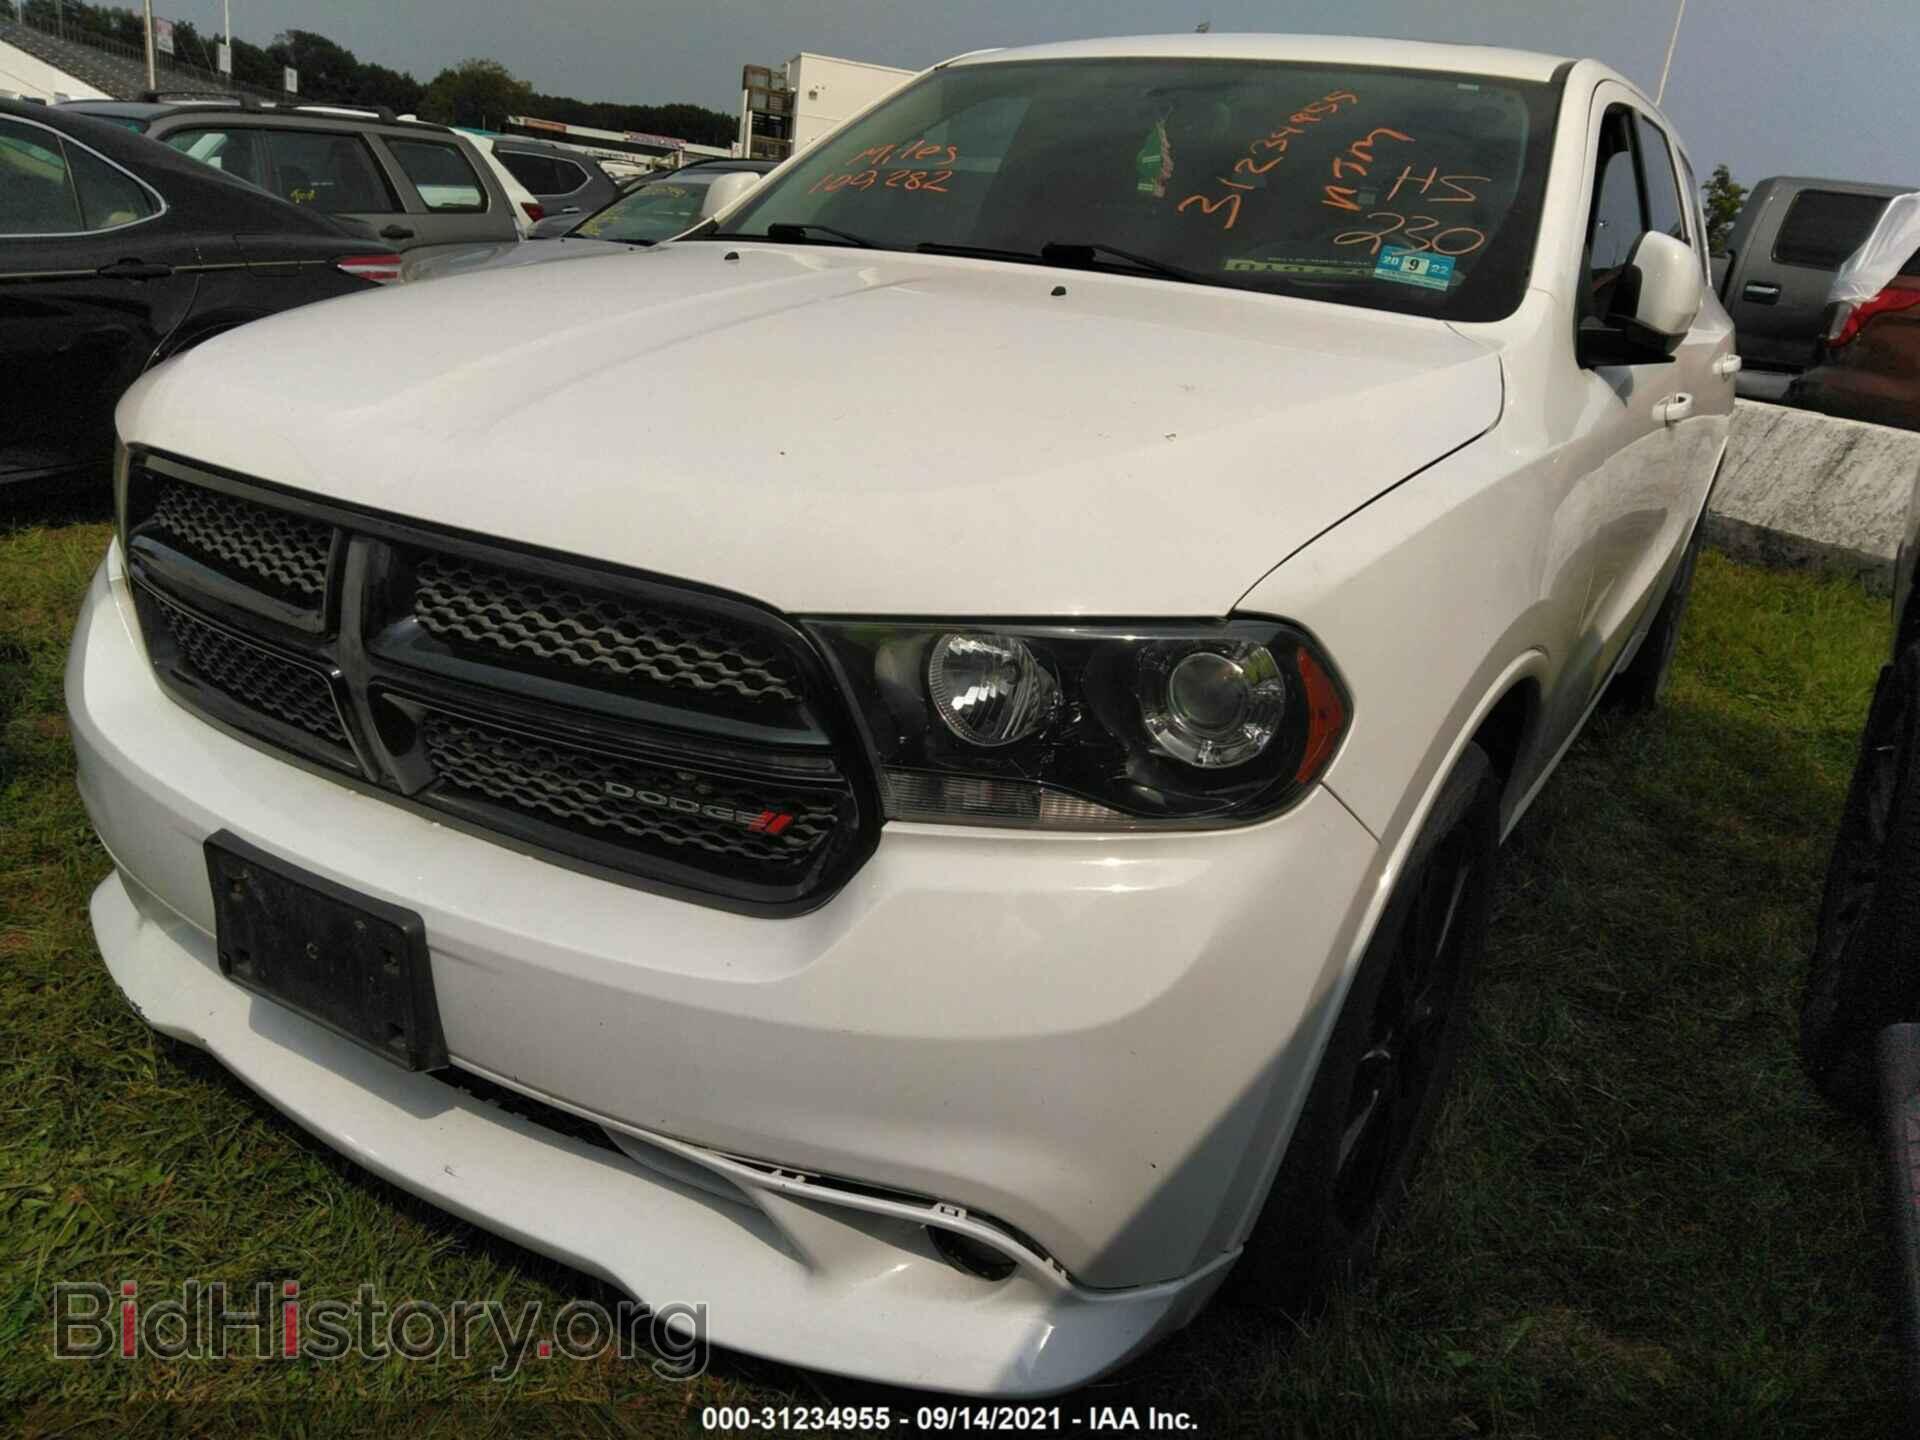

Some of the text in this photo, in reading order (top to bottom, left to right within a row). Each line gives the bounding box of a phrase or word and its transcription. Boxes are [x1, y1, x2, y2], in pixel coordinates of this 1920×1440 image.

[846, 139, 957, 165] Miles
[1333, 212, 1485, 256] 230
[1408, 258, 1420, 271] 9
[1430, 264, 1449, 275] 22
[605, 781, 767, 828] DODGE
